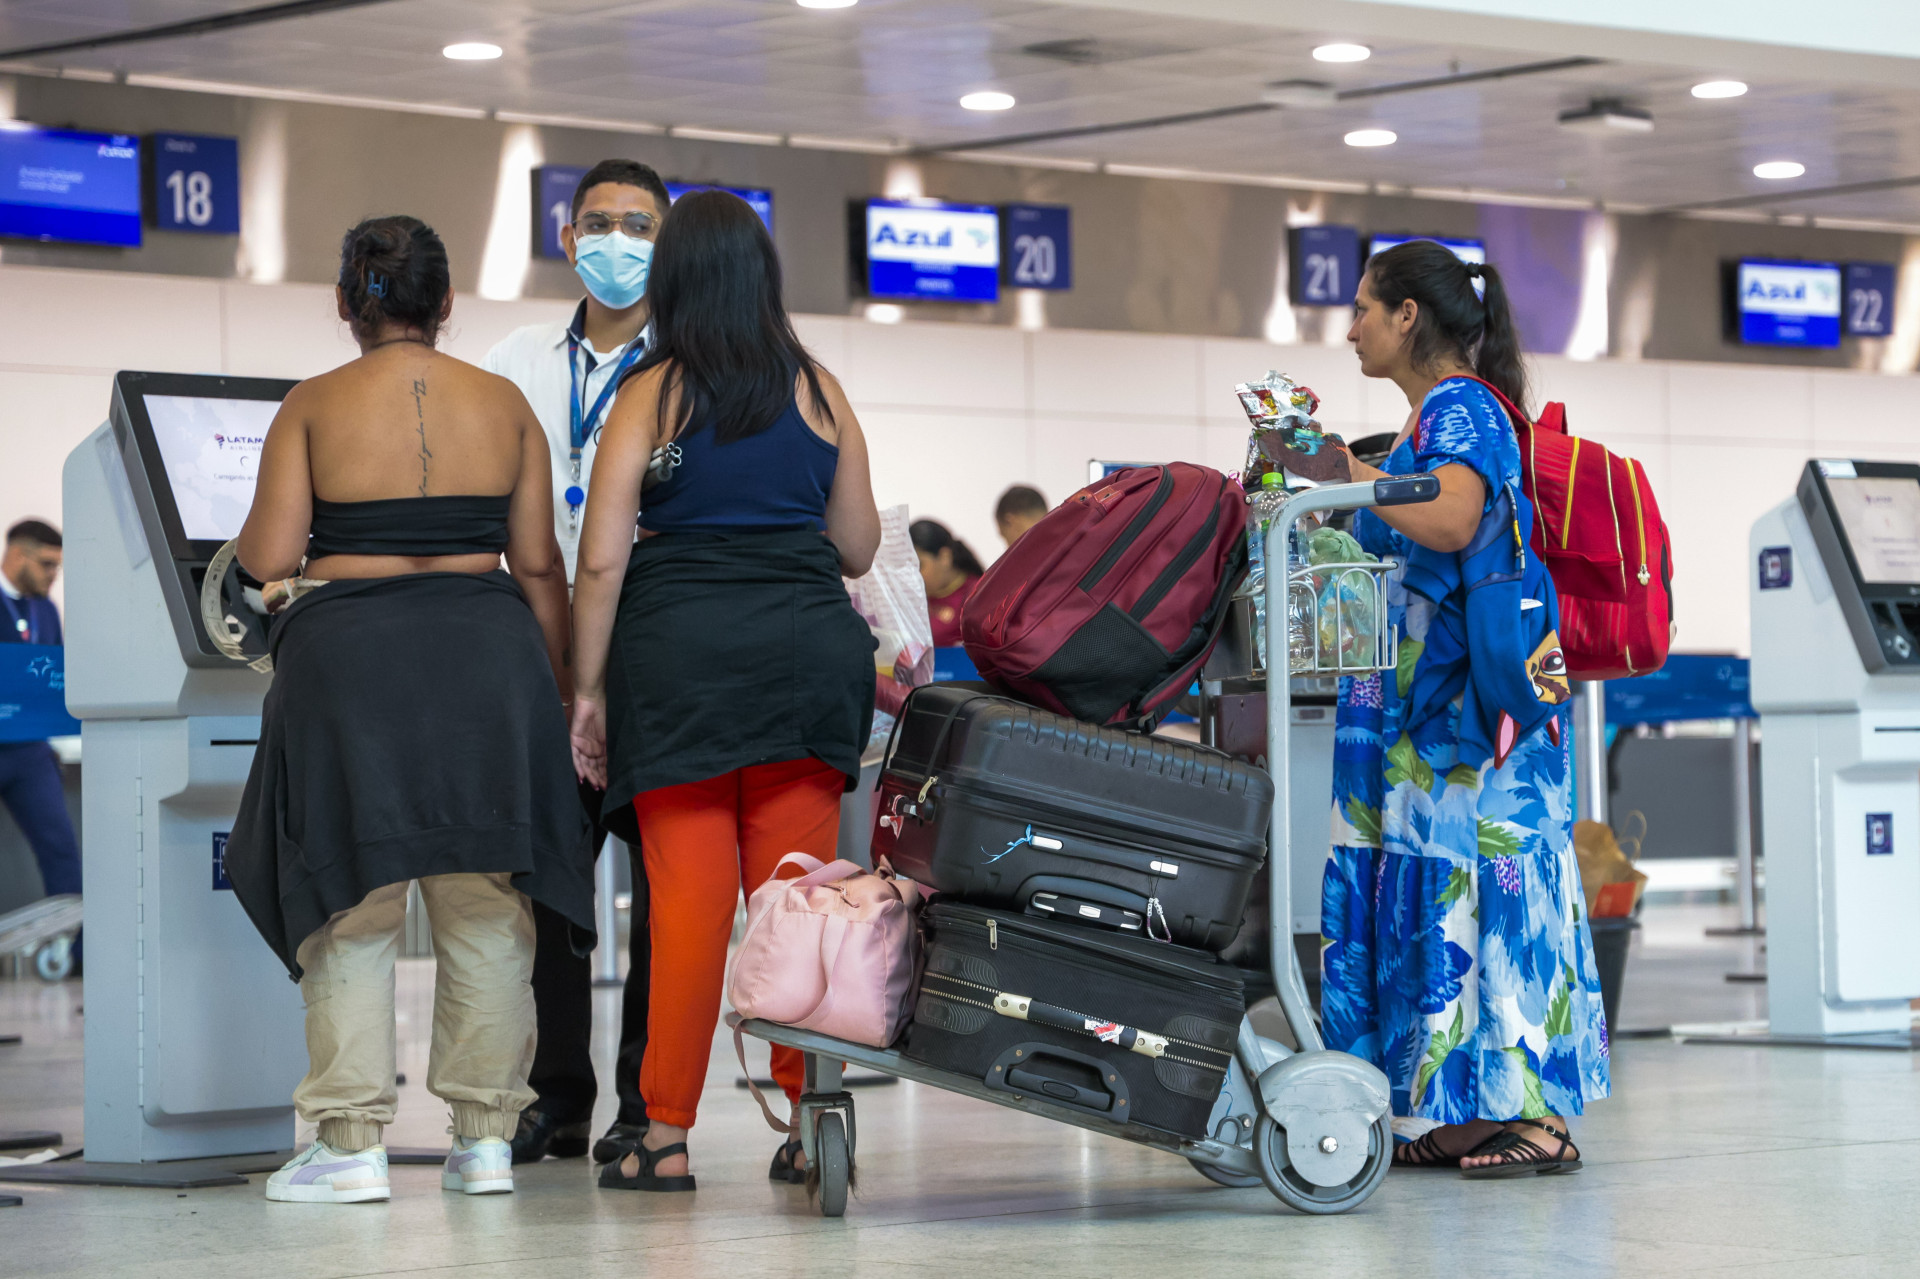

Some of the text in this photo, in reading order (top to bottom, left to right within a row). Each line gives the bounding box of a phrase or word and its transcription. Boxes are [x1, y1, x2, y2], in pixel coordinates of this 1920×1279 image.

[166, 170, 213, 226] 18
[875, 223, 953, 247] Azul
[1014, 234, 1057, 284] 20
[1305, 253, 1341, 300] 21
[1748, 279, 1806, 300] Azul
[1851, 288, 1884, 333] 22
[226, 436, 264, 444] LATAM
